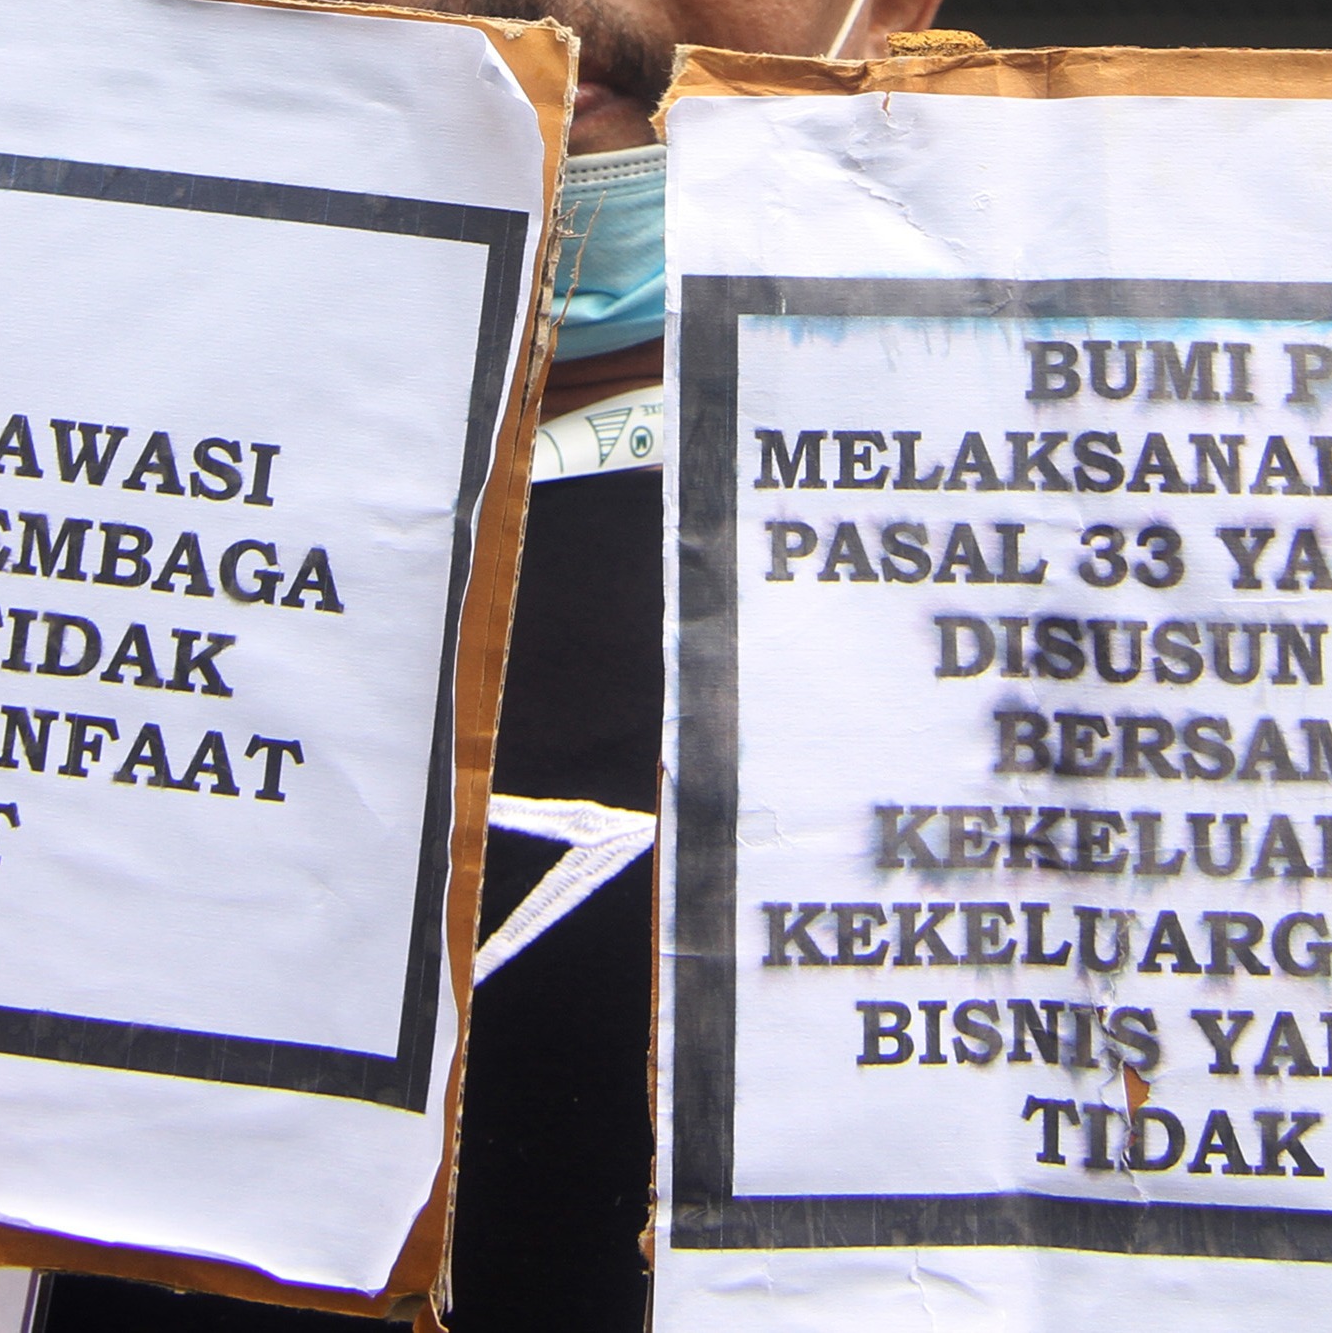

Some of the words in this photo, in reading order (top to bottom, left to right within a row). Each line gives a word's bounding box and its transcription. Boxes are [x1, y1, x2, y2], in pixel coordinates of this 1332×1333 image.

[1026, 340, 1256, 403] BUMI
[764, 519, 1048, 588] PASAL
[1078, 522, 1185, 590] 33
[934, 614, 1329, 686] DISUSUN
[854, 999, 1162, 1074] BISNIS
[1022, 1095, 1326, 1178] TIDAK
